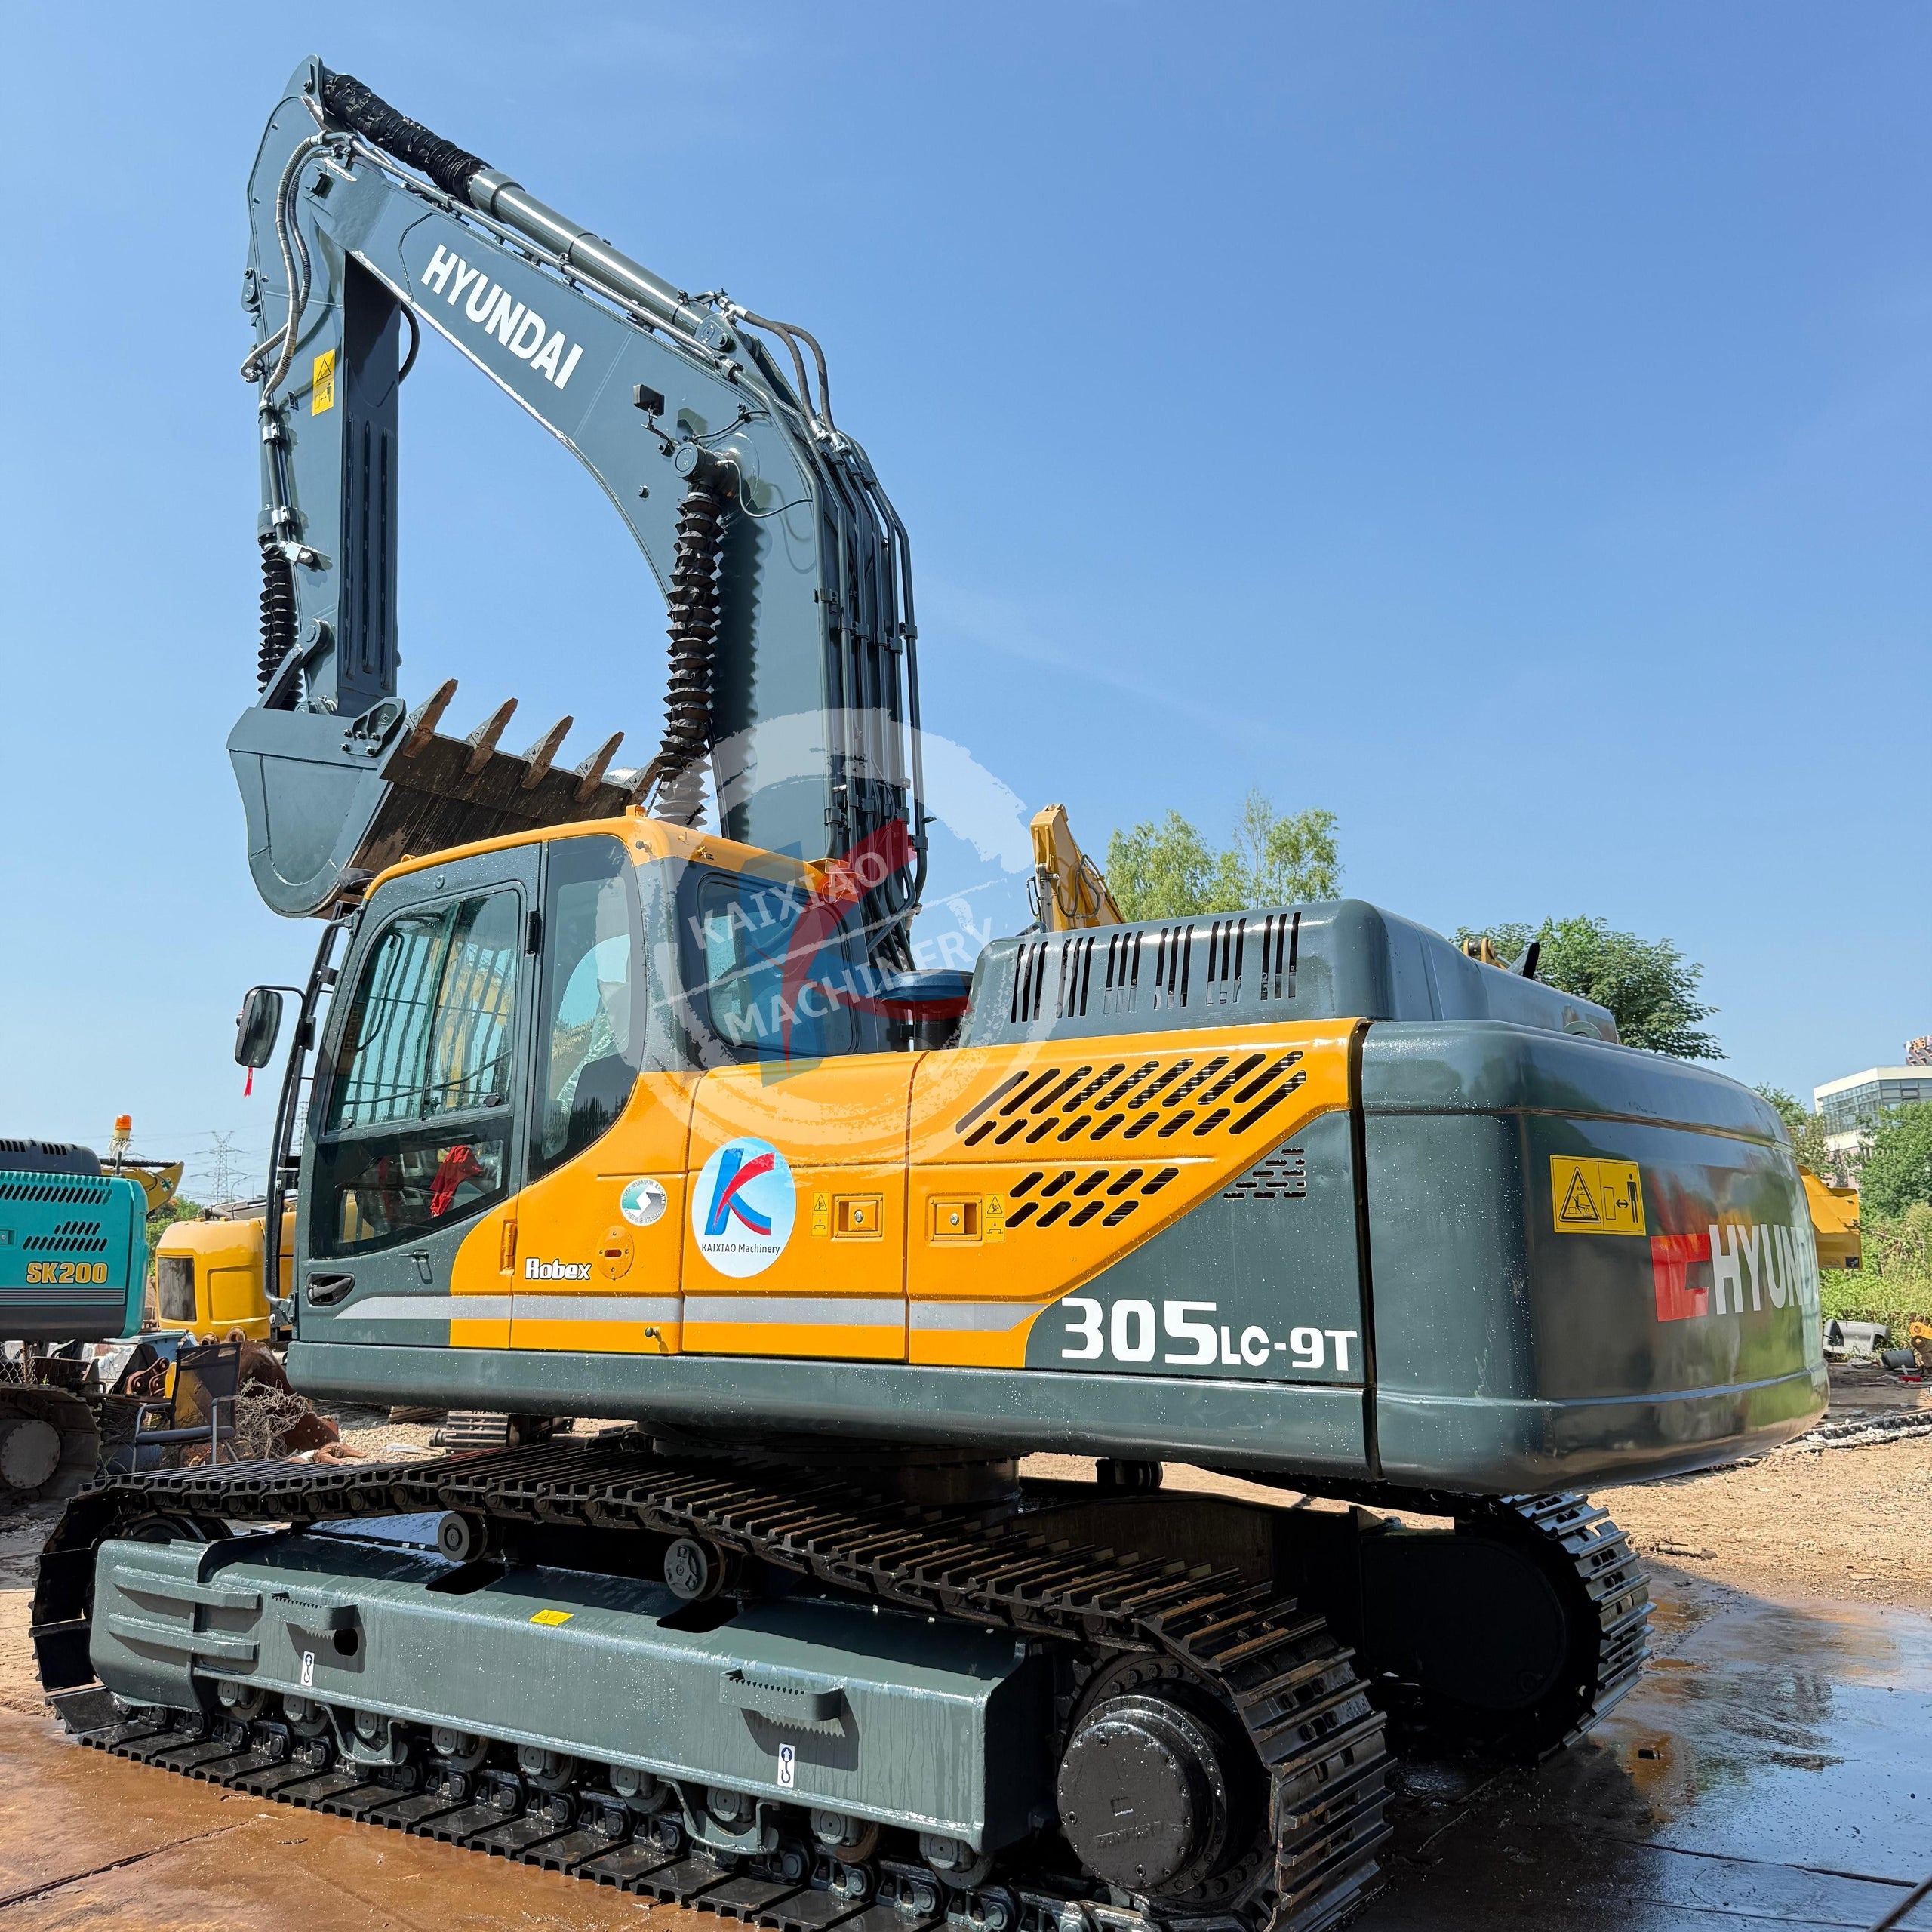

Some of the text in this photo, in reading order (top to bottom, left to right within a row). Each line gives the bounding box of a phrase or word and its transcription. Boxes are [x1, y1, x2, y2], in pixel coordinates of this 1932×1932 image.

[420, 243, 584, 390] HYUNDAI
[701, 1243, 780, 1256] KAIXIAO Machinery
[26, 1260, 109, 1284] SK200
[525, 1257, 592, 1281] Robex
